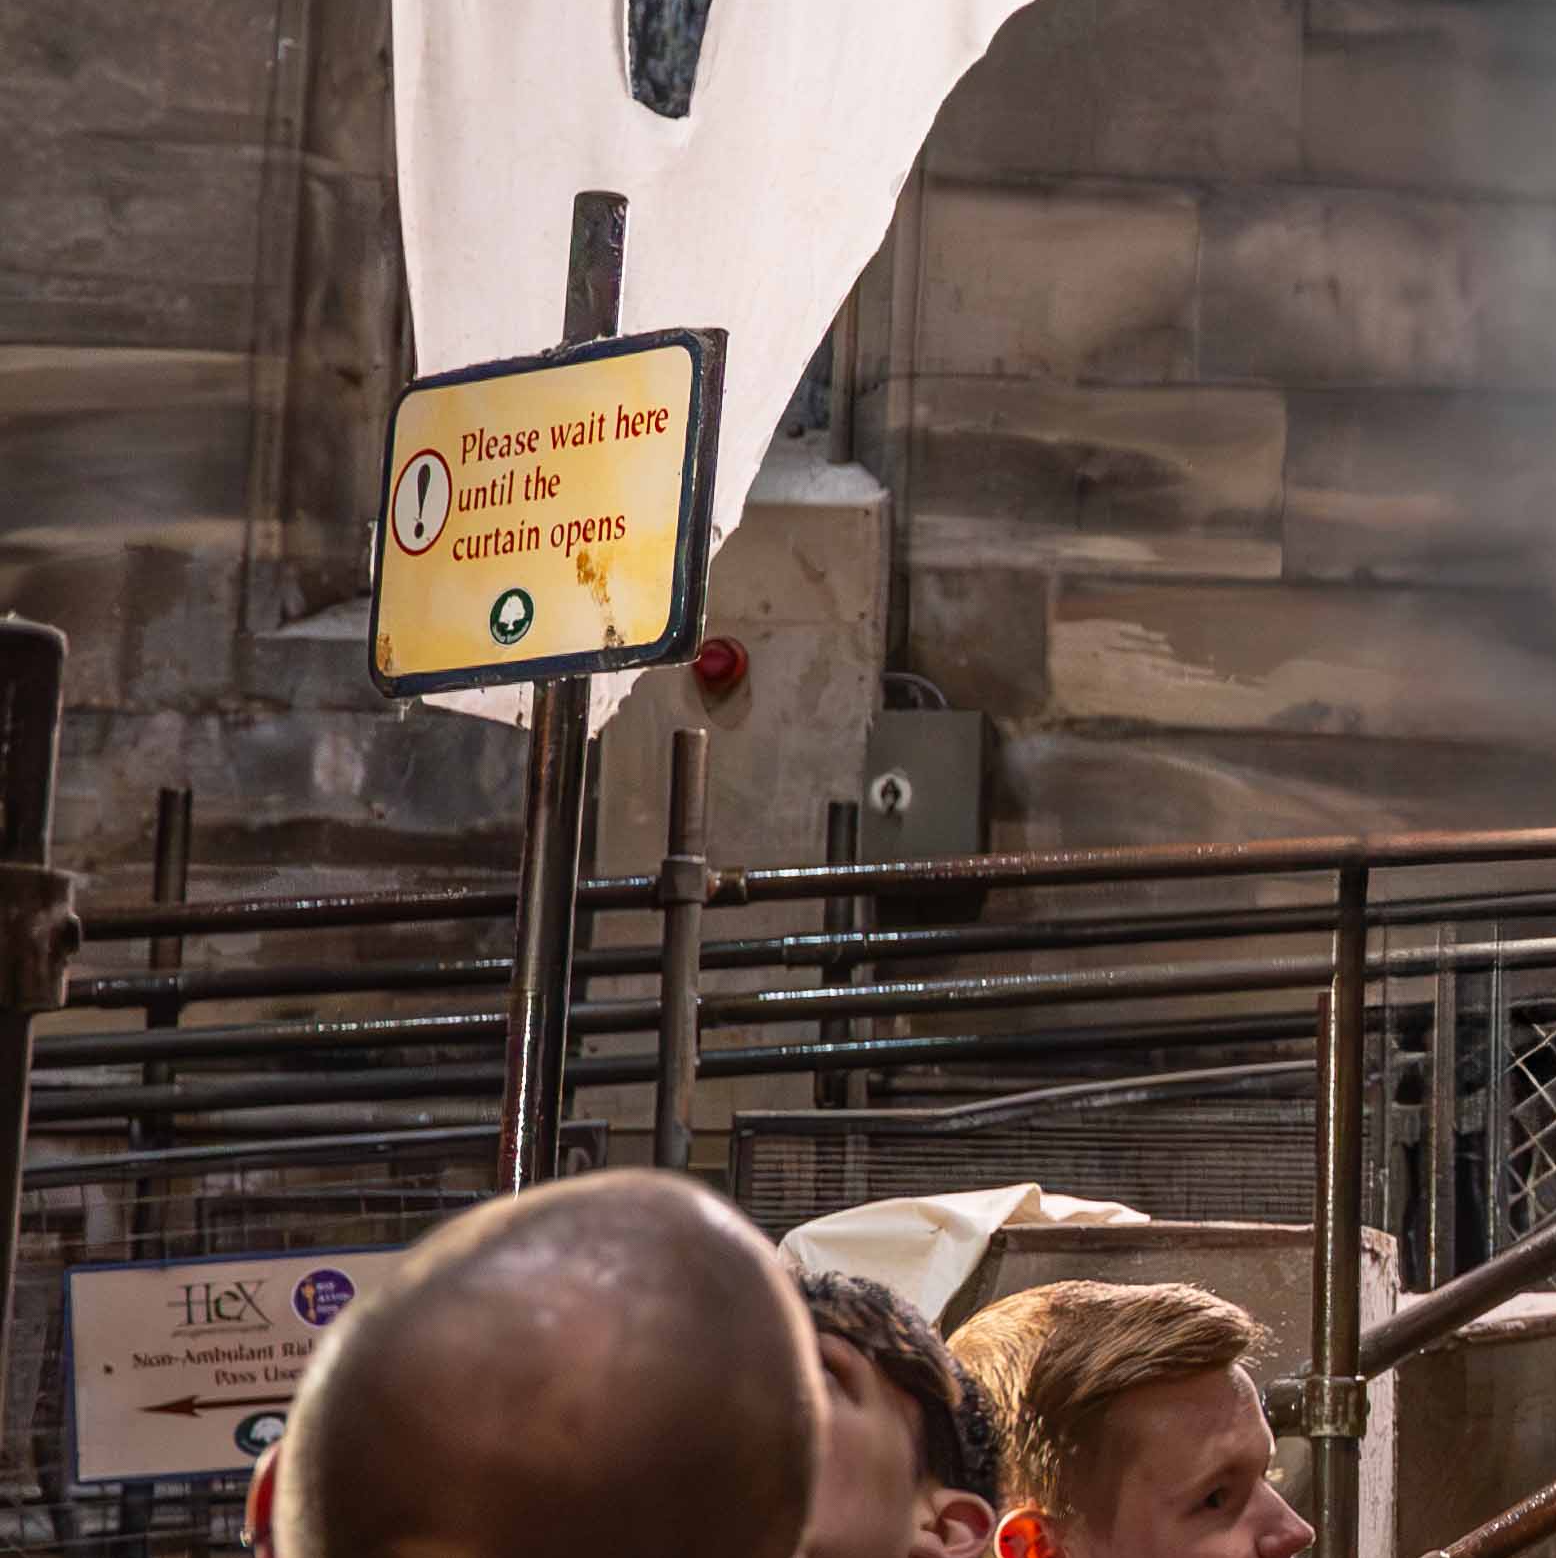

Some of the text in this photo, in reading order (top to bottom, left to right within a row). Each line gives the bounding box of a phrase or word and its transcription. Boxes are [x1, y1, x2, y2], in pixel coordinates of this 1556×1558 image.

[461, 404, 669, 466] Please wait here
[457, 466, 562, 513] until the
[452, 514, 627, 562] curtain opens
[132, 1344, 275, 1370] Non-Ambulant
[214, 1367, 257, 1388] Pass
